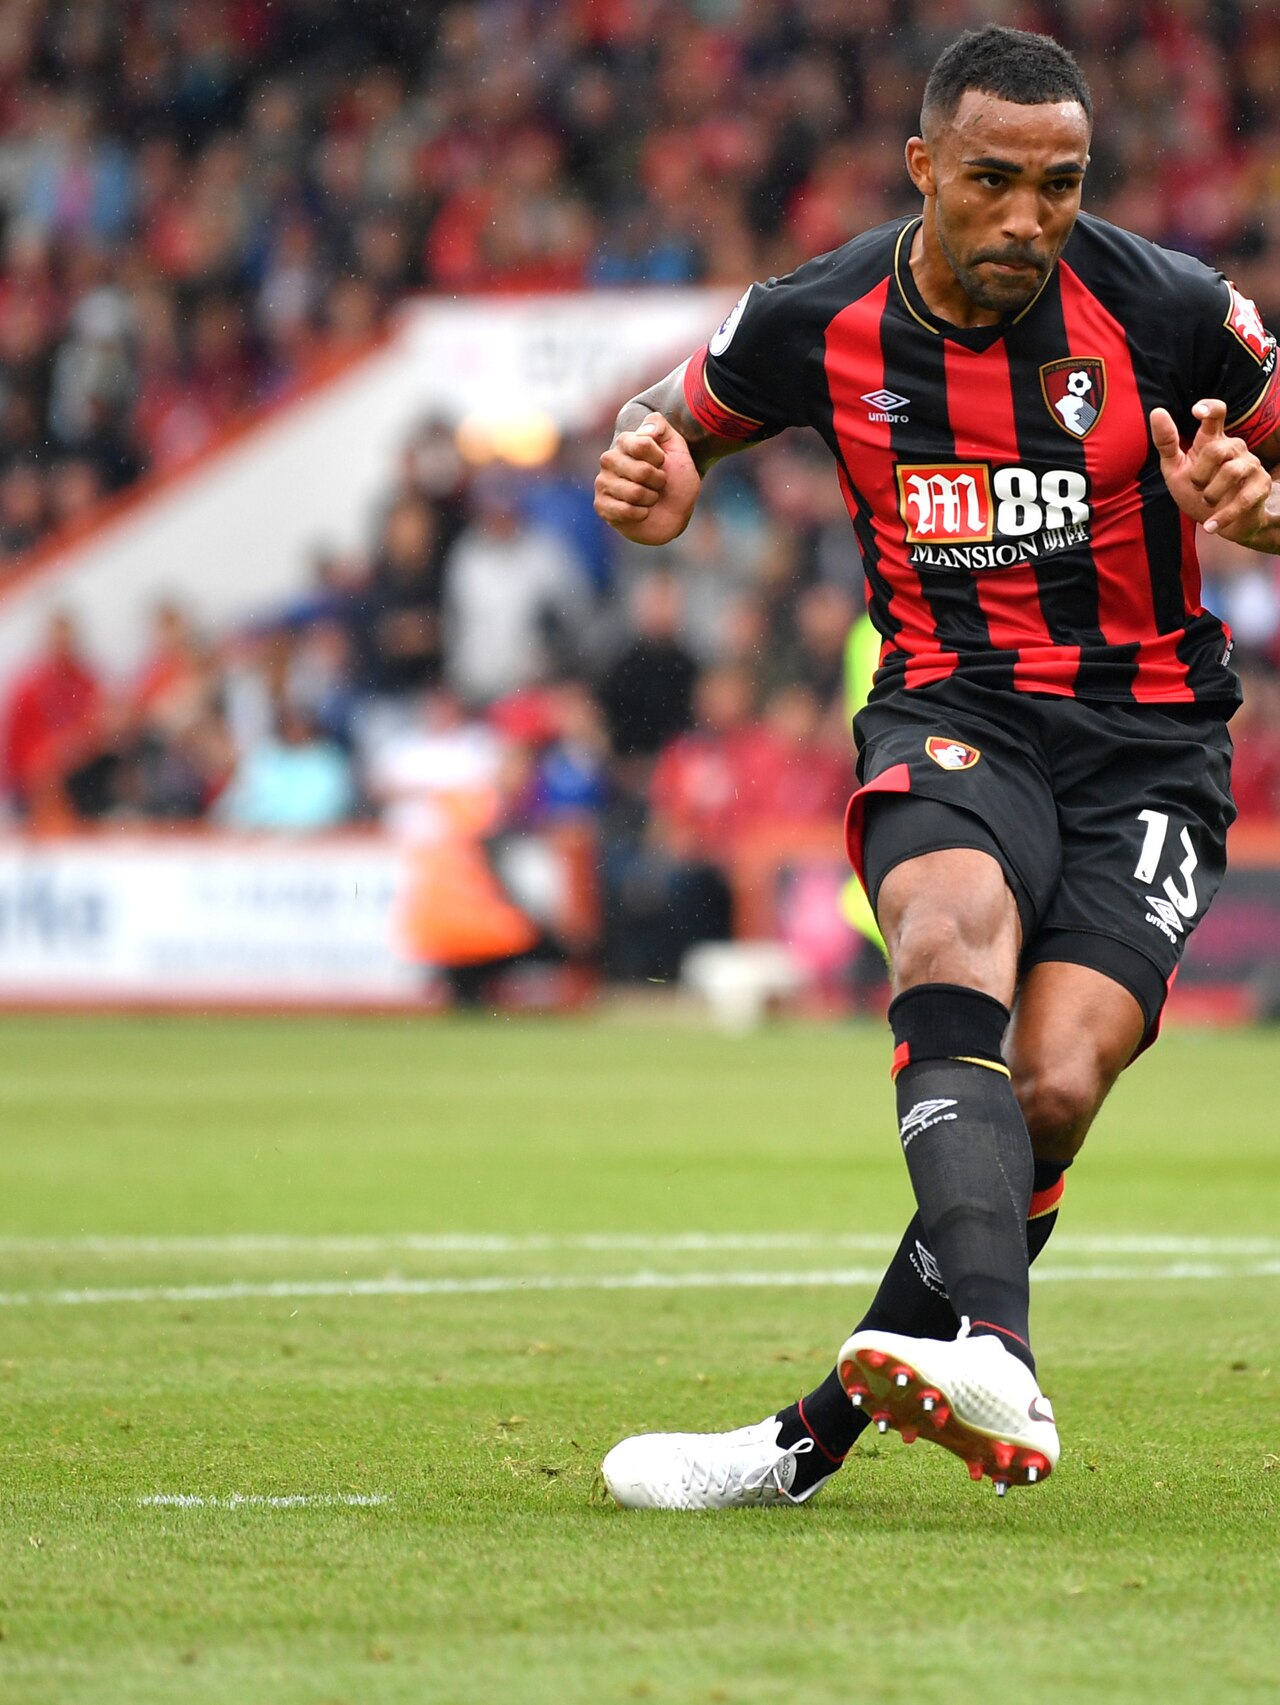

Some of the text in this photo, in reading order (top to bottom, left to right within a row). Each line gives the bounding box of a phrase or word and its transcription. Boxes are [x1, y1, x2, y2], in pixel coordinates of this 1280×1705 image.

[868, 411, 909, 423] umbro
[911, 535, 1039, 569] MANSION
[1133, 809, 1198, 918] 13
[1145, 912, 1177, 944] umbro
[903, 1112, 958, 1151] umbro
[909, 1252, 950, 1300] umbro
